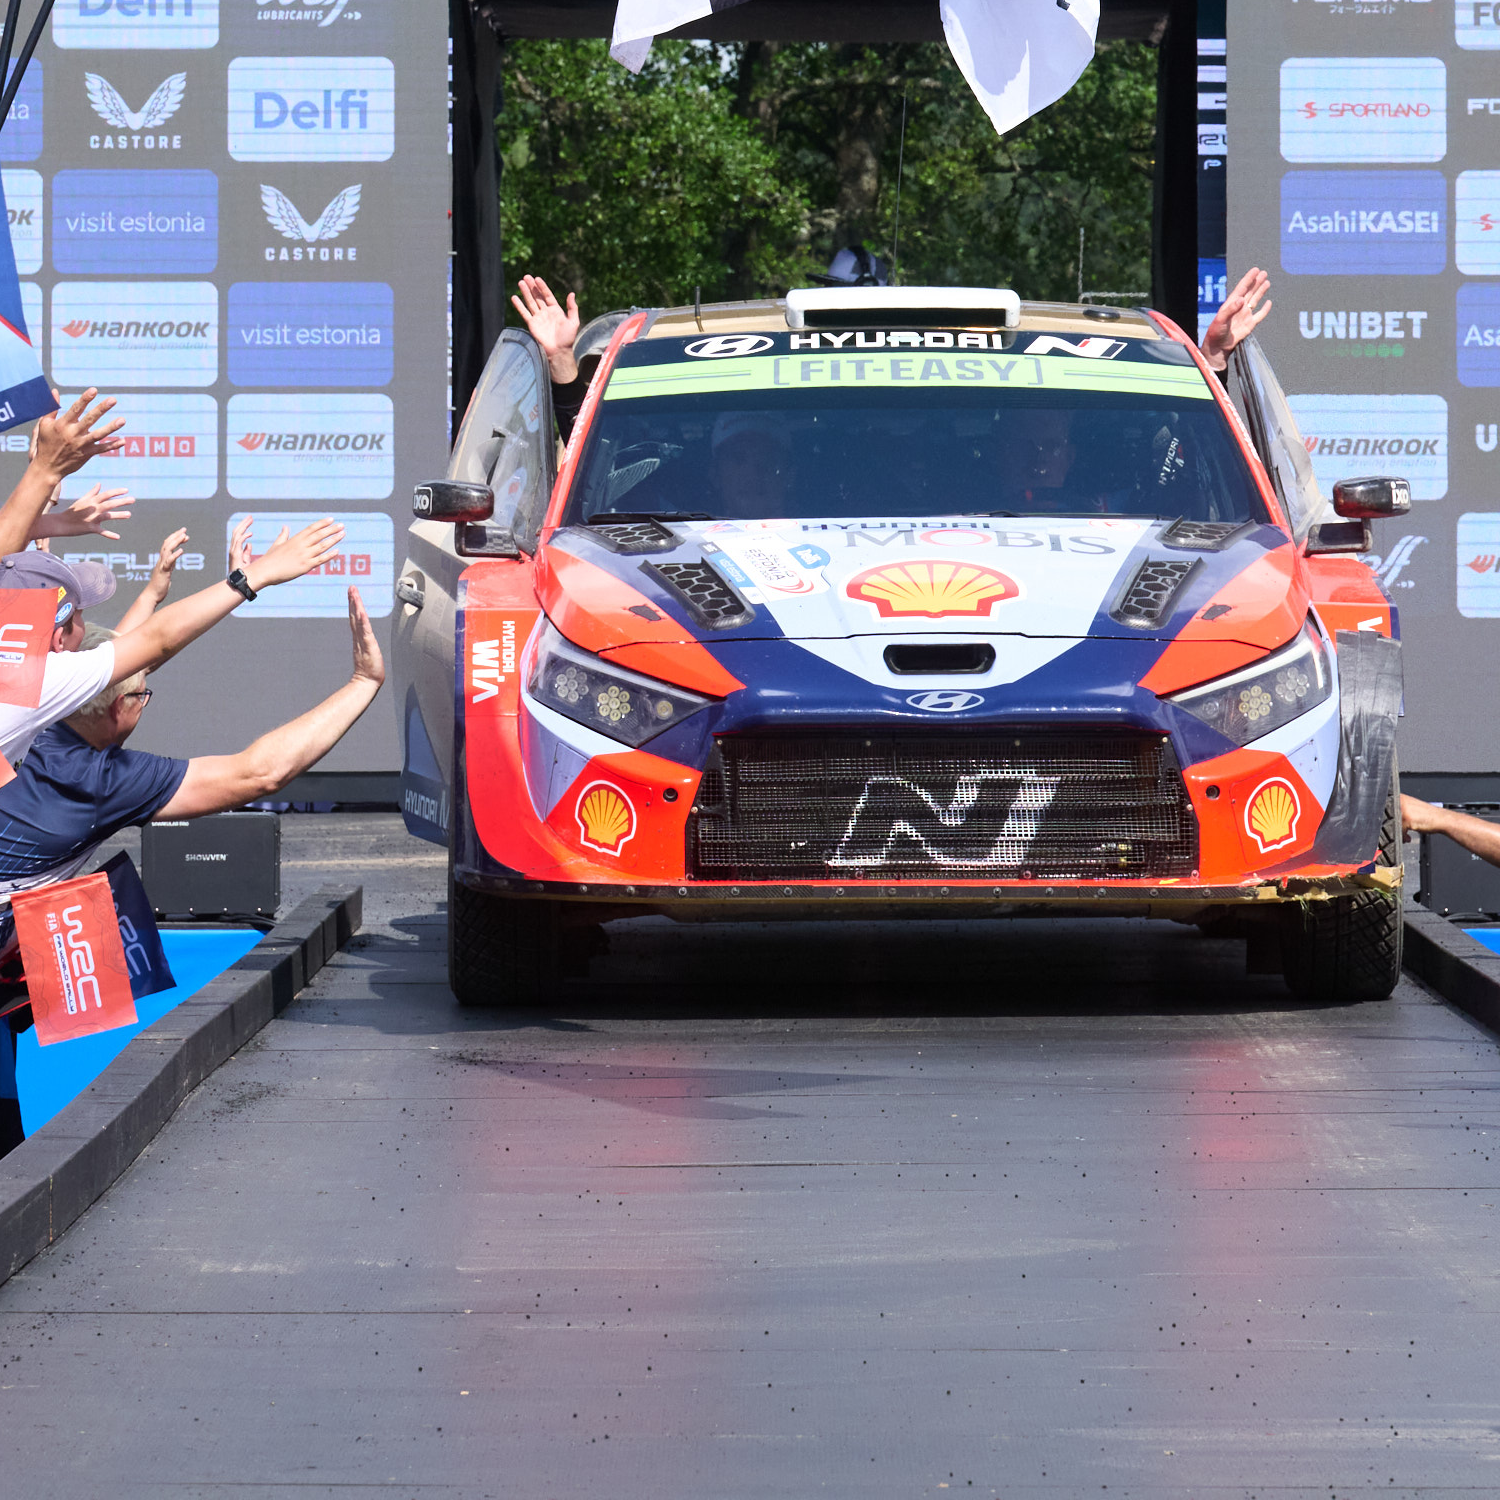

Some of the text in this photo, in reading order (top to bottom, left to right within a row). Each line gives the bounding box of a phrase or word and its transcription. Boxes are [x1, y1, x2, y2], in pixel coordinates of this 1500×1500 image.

[258, 11, 325, 21] LUBRICANTS
[254, 90, 368, 130] Delfi
[1328, 102, 1430, 118] SPORTLAND
[89, 134, 182, 149] CASTORE
[63, 211, 203, 233] visit estonia
[1288, 211, 1439, 235] AsahiKASEI
[264, 247, 357, 262] CASTORE
[239, 324, 379, 346] visit estonia
[1300, 310, 1428, 338] UNIBET
[790, 331, 1003, 350] HYUNDAI
[844, 528, 1117, 556] MOBIS
[502, 620, 516, 673] HYUNDAI
[404, 788, 439, 823] HYUNDAI
[62, 904, 102, 1012] WRC
